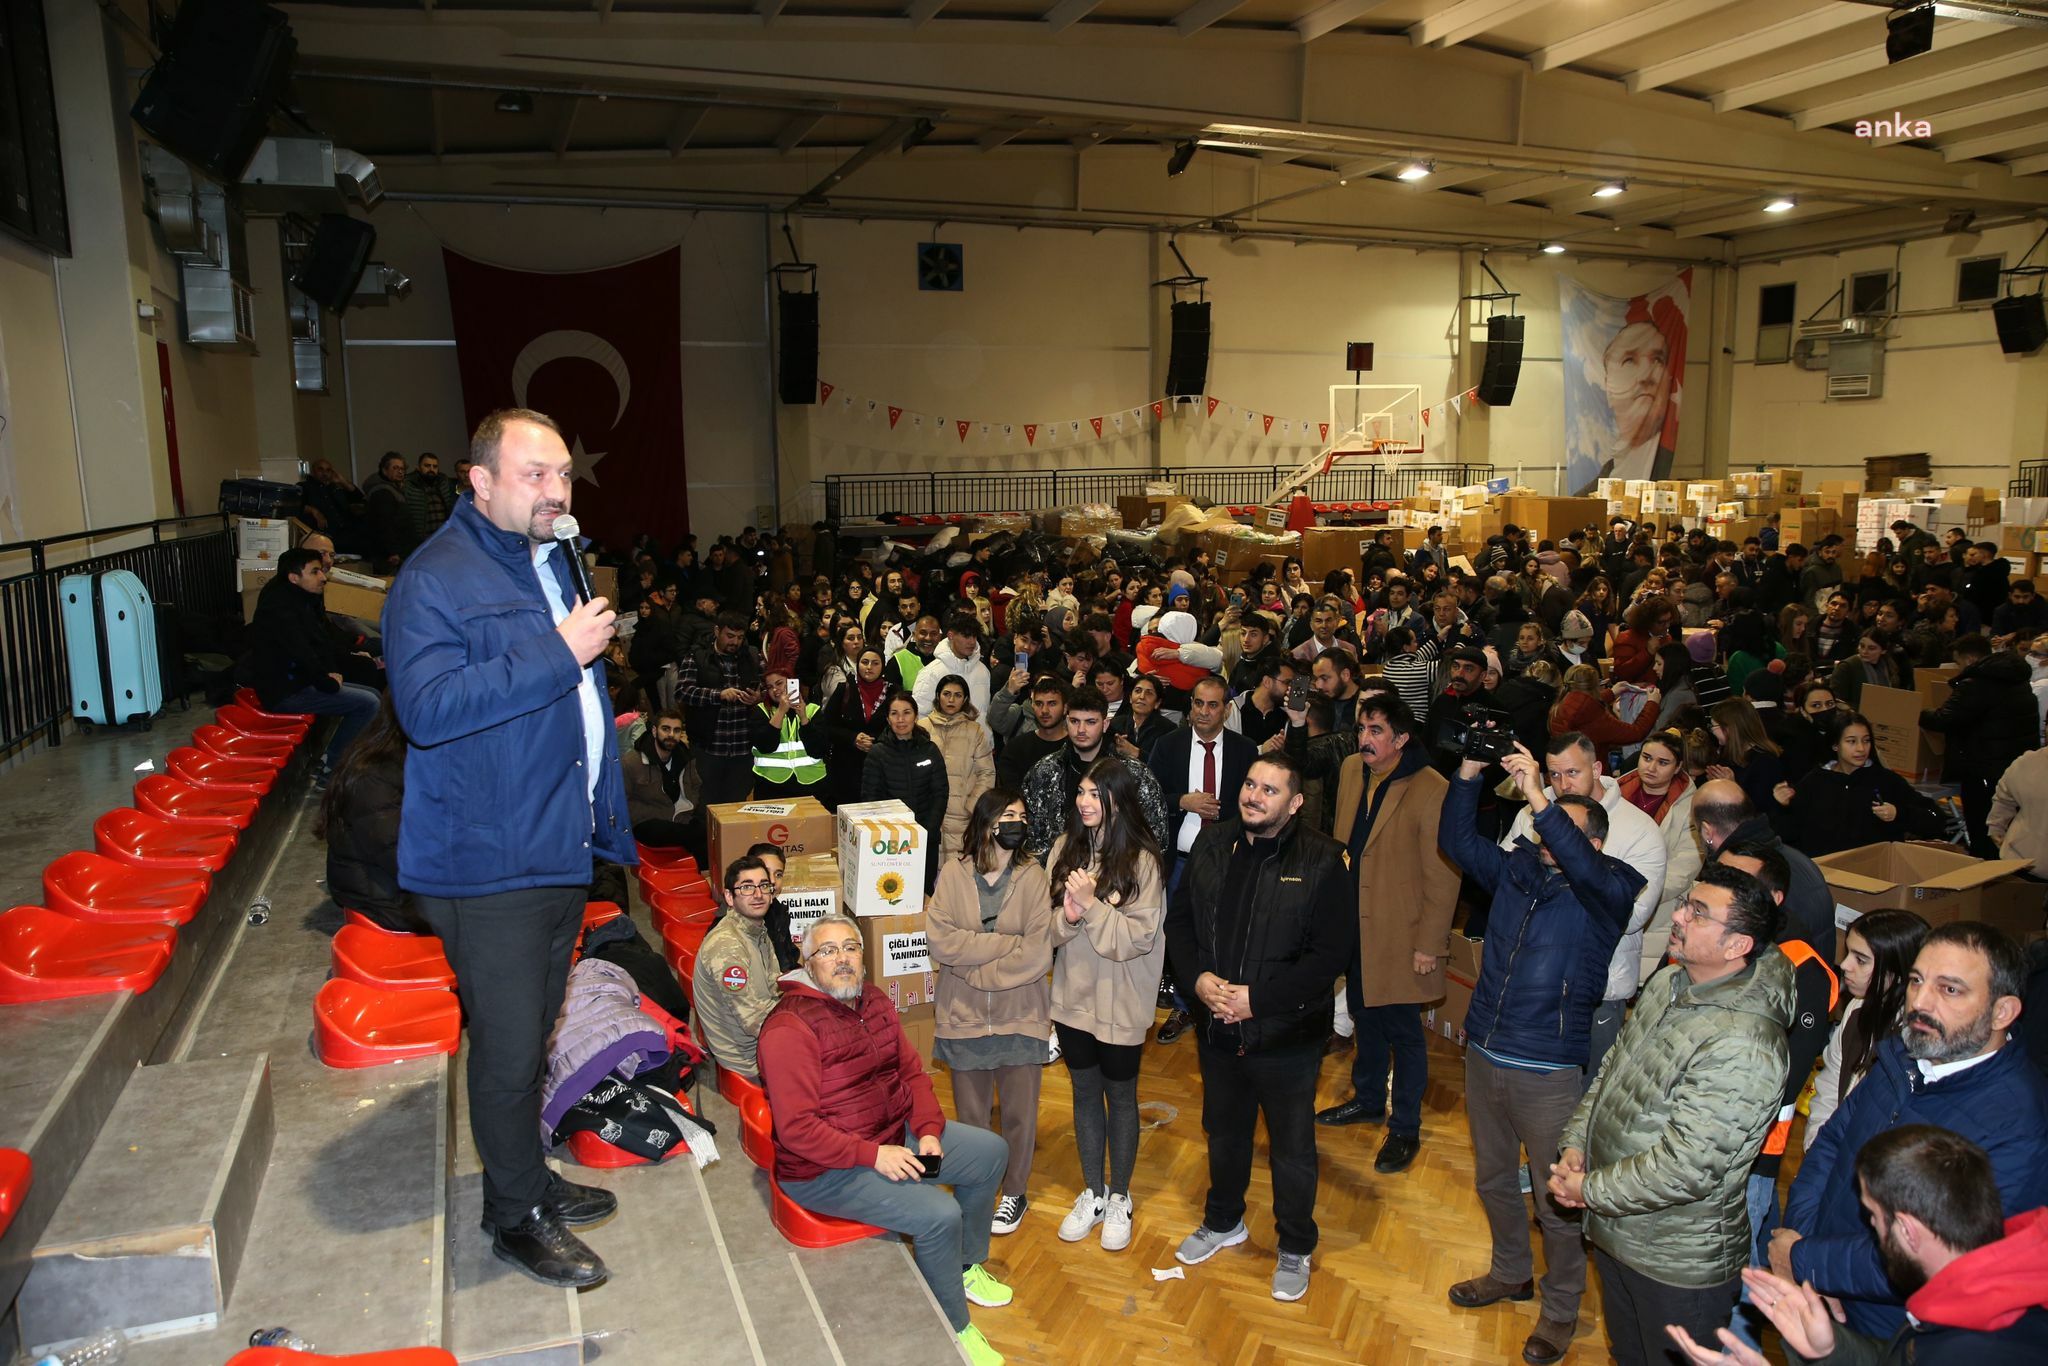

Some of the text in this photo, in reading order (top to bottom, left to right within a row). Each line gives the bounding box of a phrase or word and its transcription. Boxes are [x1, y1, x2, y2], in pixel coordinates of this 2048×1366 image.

[872, 839, 912, 855] OBA
[804, 898, 829, 907] HALKI
[888, 938, 928, 951] ÇİĞLİ HAL
